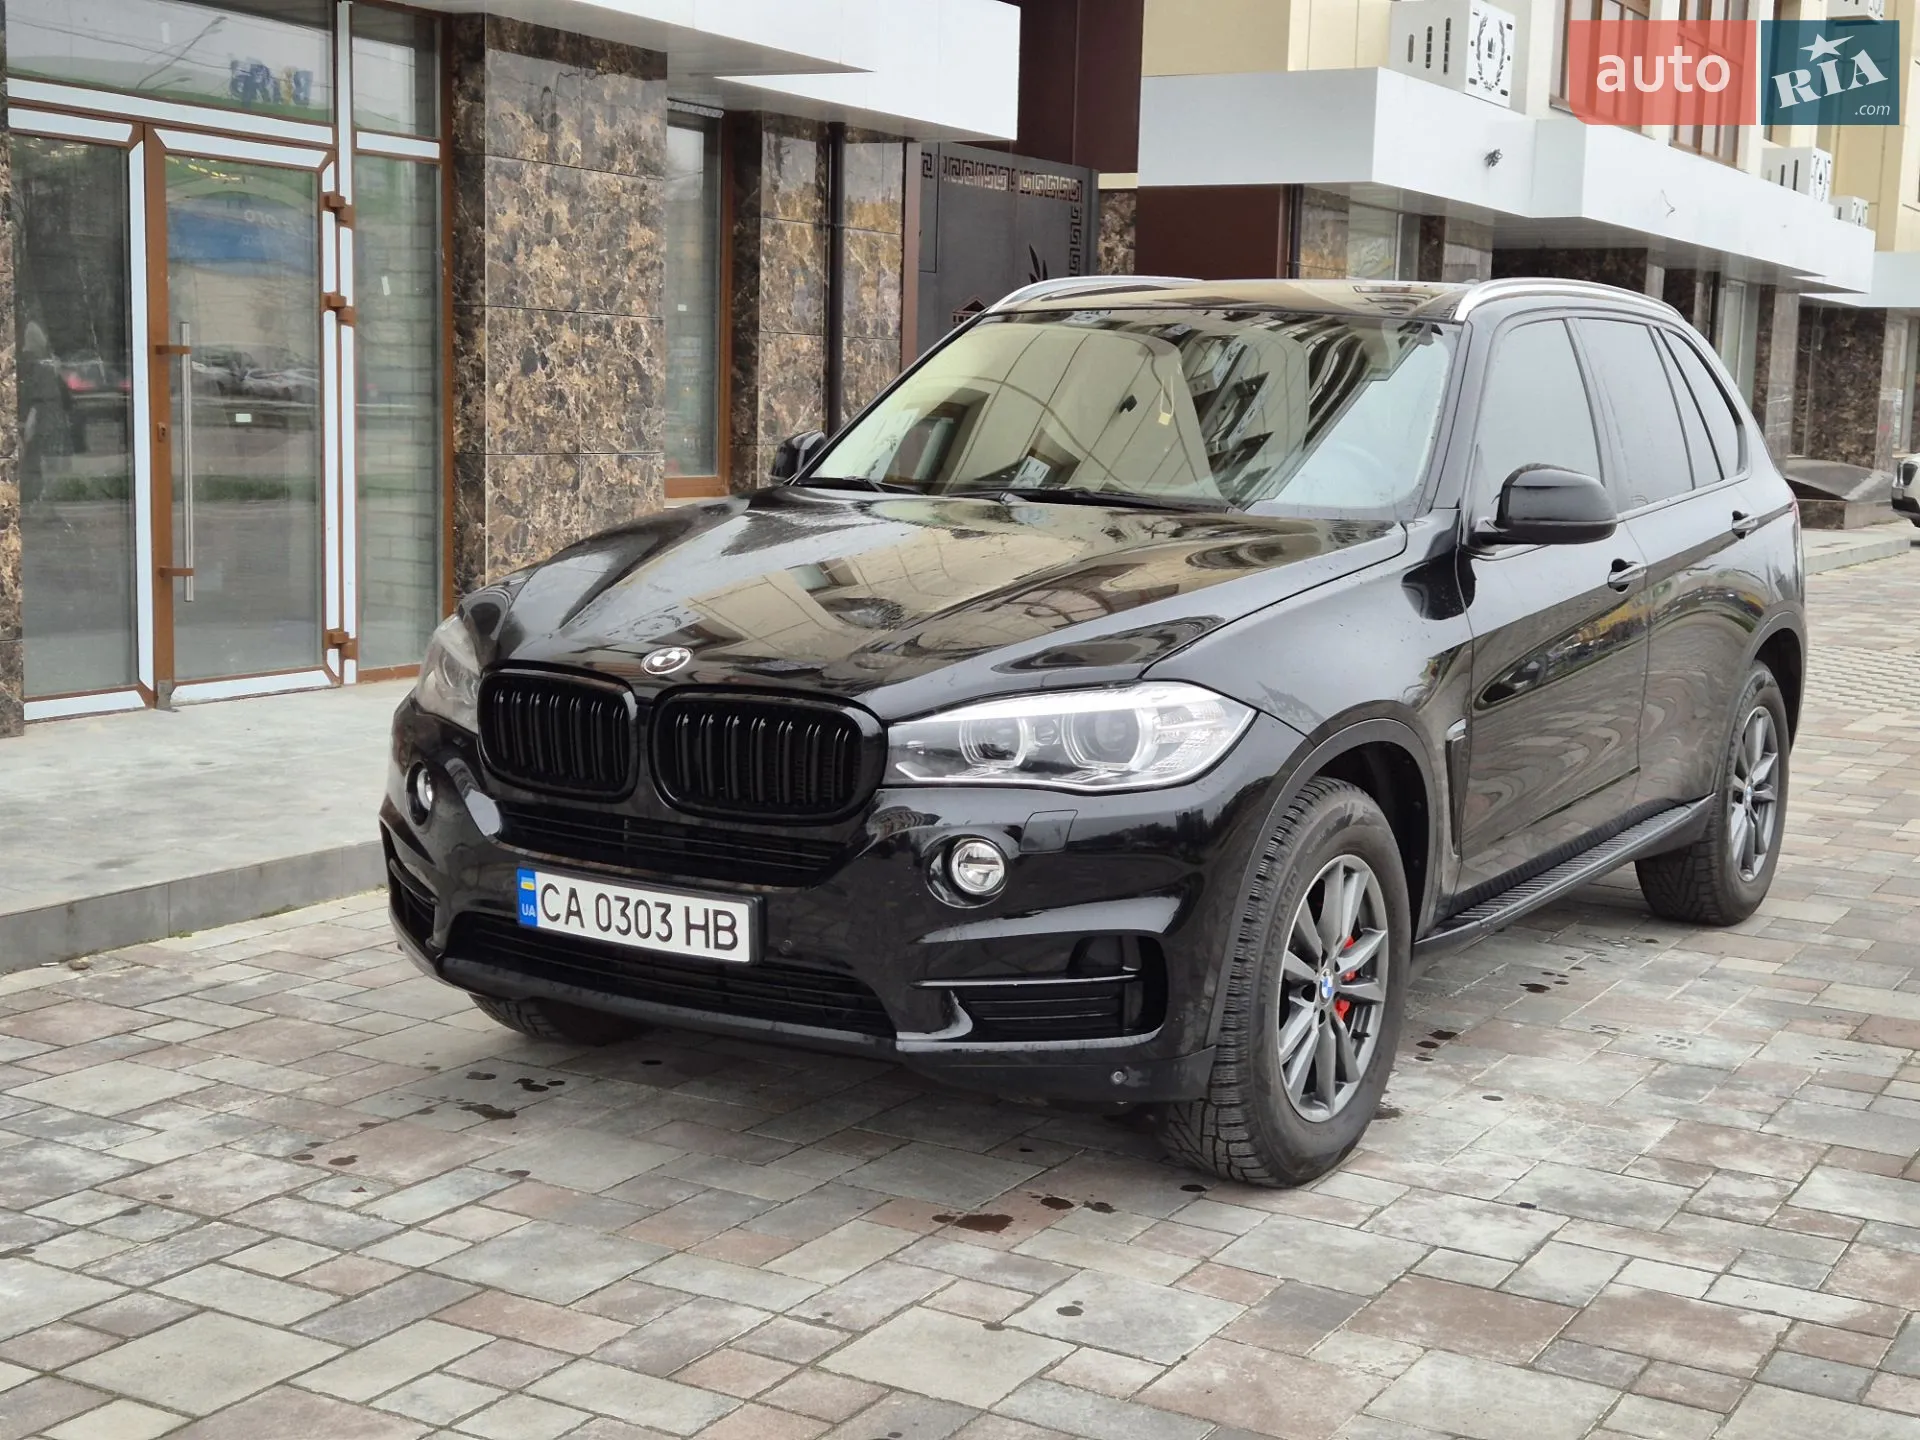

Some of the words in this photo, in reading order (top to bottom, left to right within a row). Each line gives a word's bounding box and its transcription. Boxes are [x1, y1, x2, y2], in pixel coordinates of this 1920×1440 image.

[521, 903, 536, 918] UA
[540, 883, 585, 928] CA
[595, 893, 673, 943] 0303
[684, 906, 738, 951] HB
